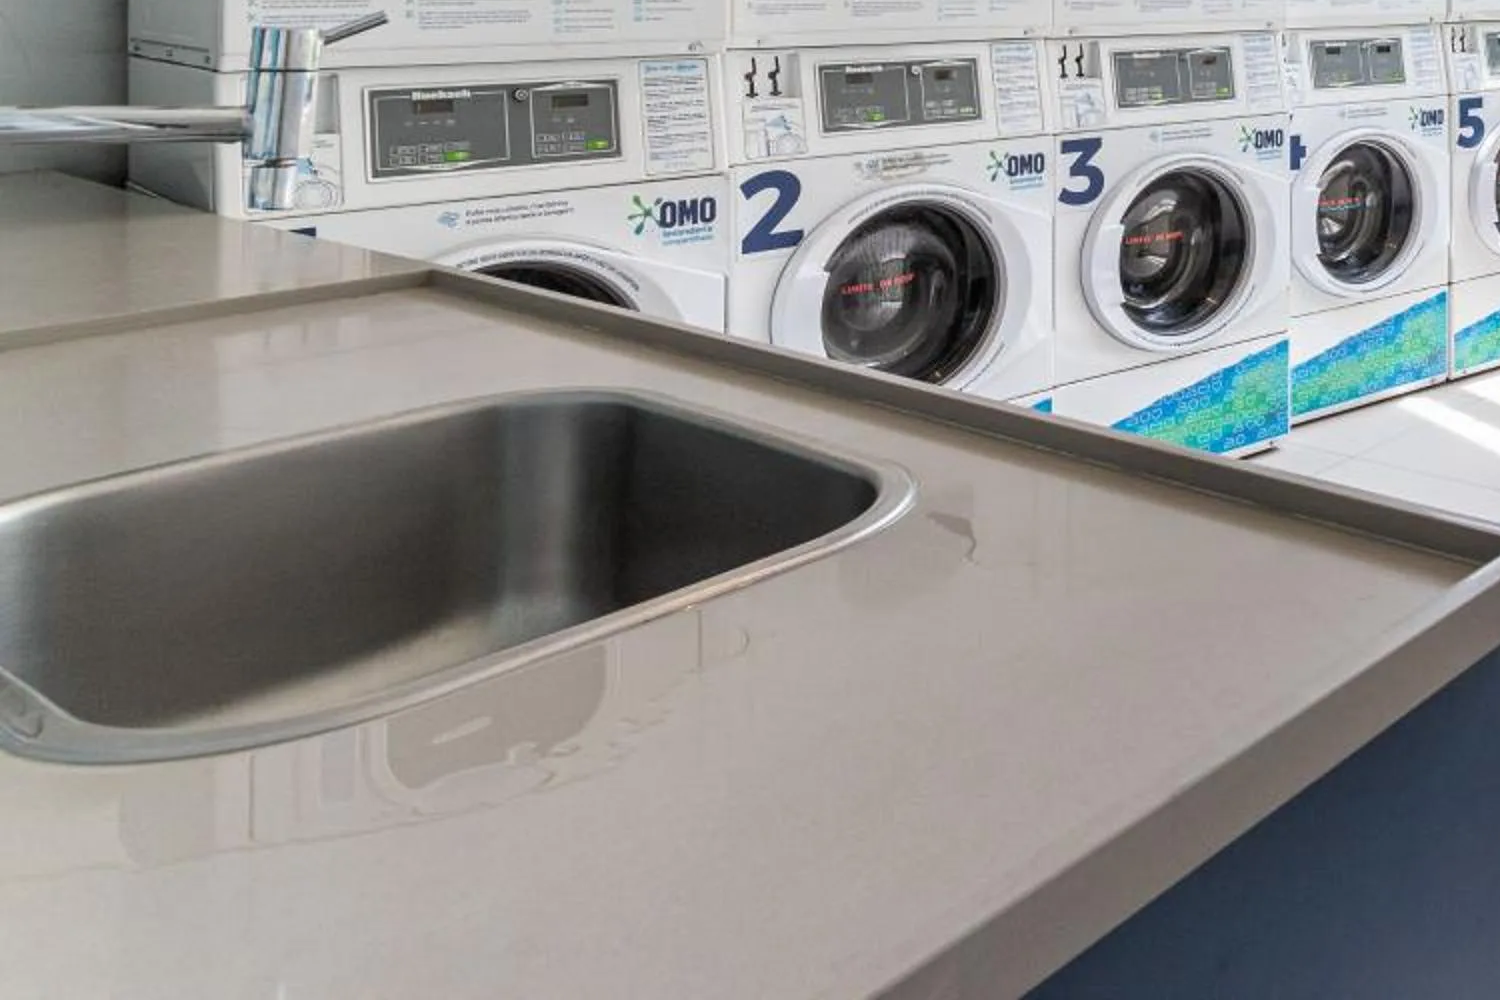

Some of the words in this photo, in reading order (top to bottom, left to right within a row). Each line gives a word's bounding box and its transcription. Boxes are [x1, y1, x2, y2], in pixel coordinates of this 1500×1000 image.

[1254, 128, 1283, 149] OMO
[1457, 96, 1485, 149] 5
[1006, 152, 1045, 177] OMO
[1058, 137, 1105, 206] 3
[659, 196, 717, 228] OMO
[739, 169, 805, 254] 2
